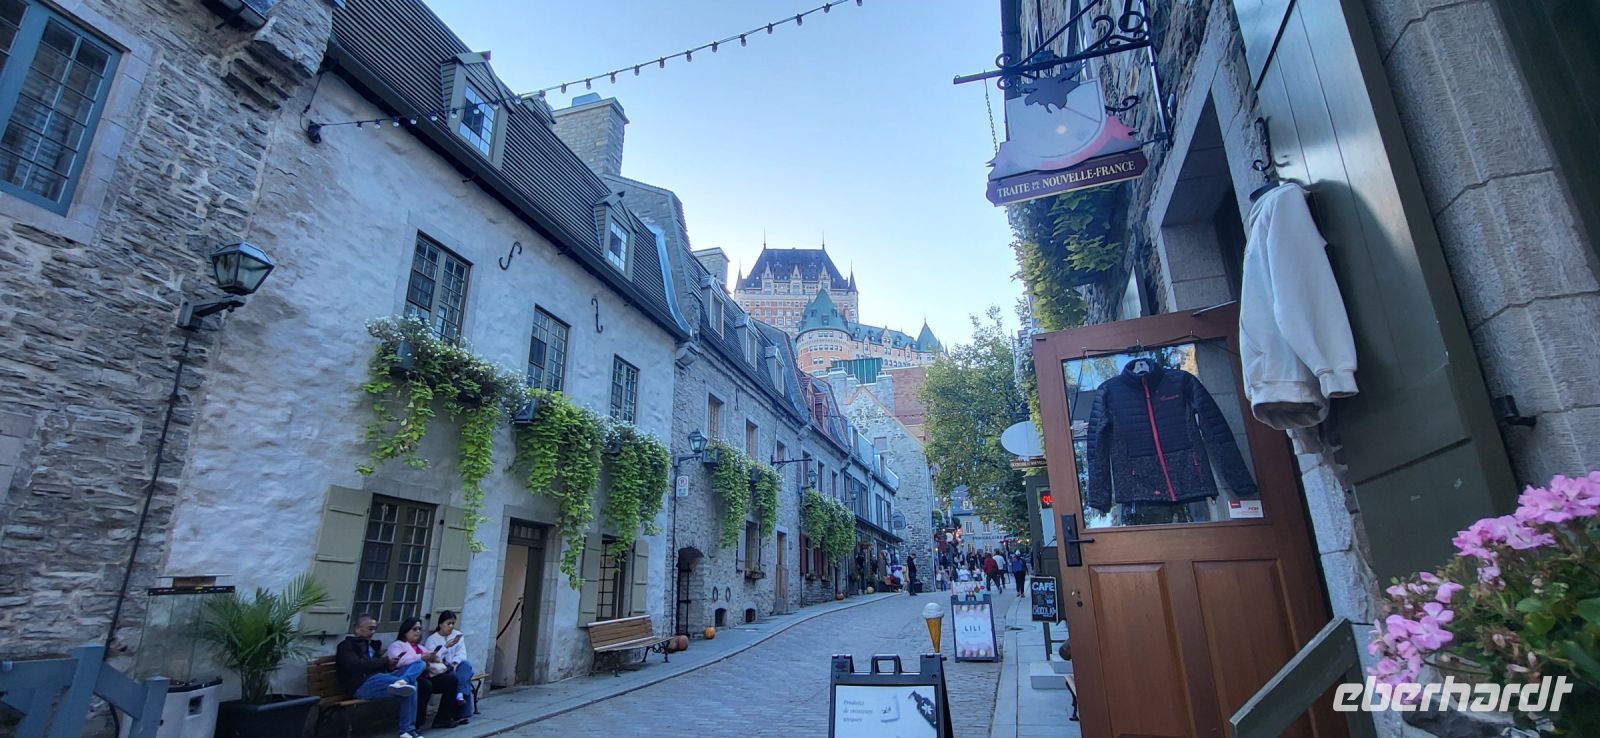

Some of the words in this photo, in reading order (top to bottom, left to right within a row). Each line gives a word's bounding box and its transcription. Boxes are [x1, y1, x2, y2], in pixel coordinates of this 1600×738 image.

[997, 182, 1030, 198] TRAITE
[1042, 160, 1136, 188] NOUVELLE-FRANCE
[1032, 581, 1055, 591] CAFÉ
